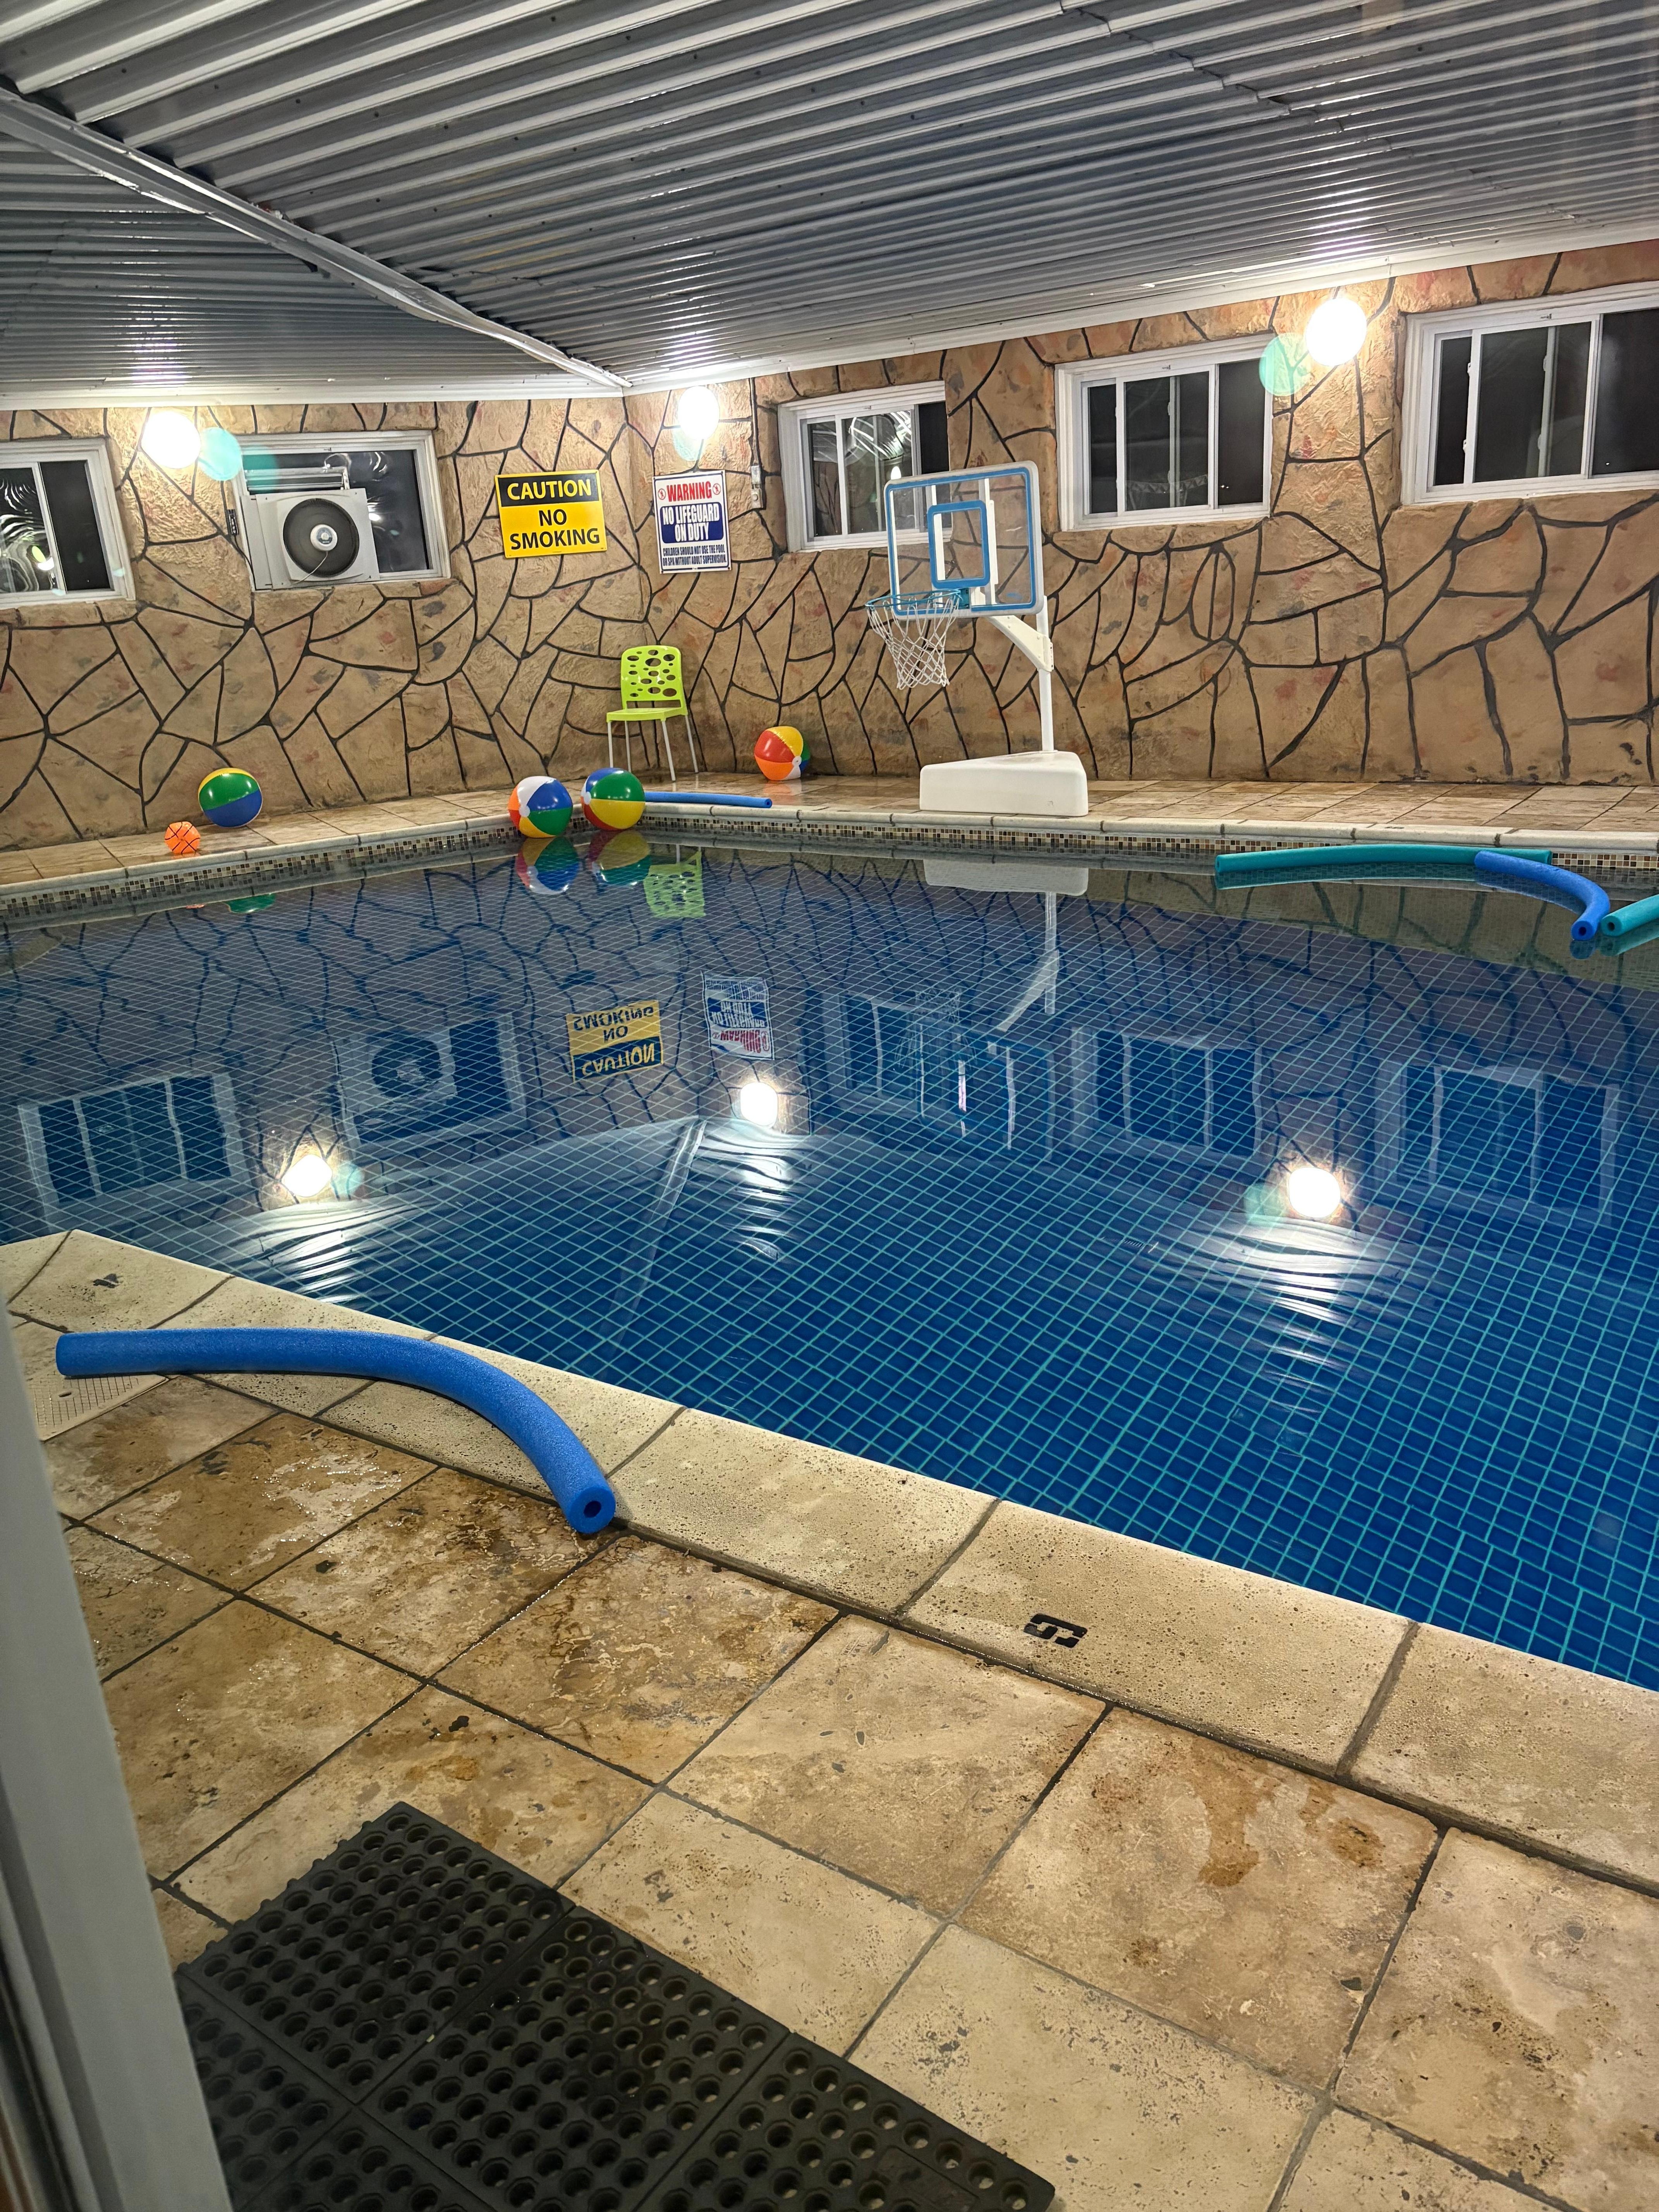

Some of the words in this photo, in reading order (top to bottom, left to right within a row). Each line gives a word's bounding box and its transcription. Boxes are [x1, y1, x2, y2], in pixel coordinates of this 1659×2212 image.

[507, 479, 592, 500] CAUTION
[666, 481, 712, 502] WARNING
[539, 509, 567, 526] NO
[663, 507, 674, 525] NO
[675, 503, 720, 524] LIFEGUARD
[510, 528, 600, 550] SMOKING
[675, 524, 687, 542] ON
[688, 522, 709, 541] DUTY
[663, 547, 680, 556] CHILDREN
[680, 546, 694, 555] SHOULD
[716, 544, 725, 553] POOL
[663, 557, 668, 566] OR
[675, 556, 691, 565] WITHOUT
[691, 555, 702, 565] ADULT
